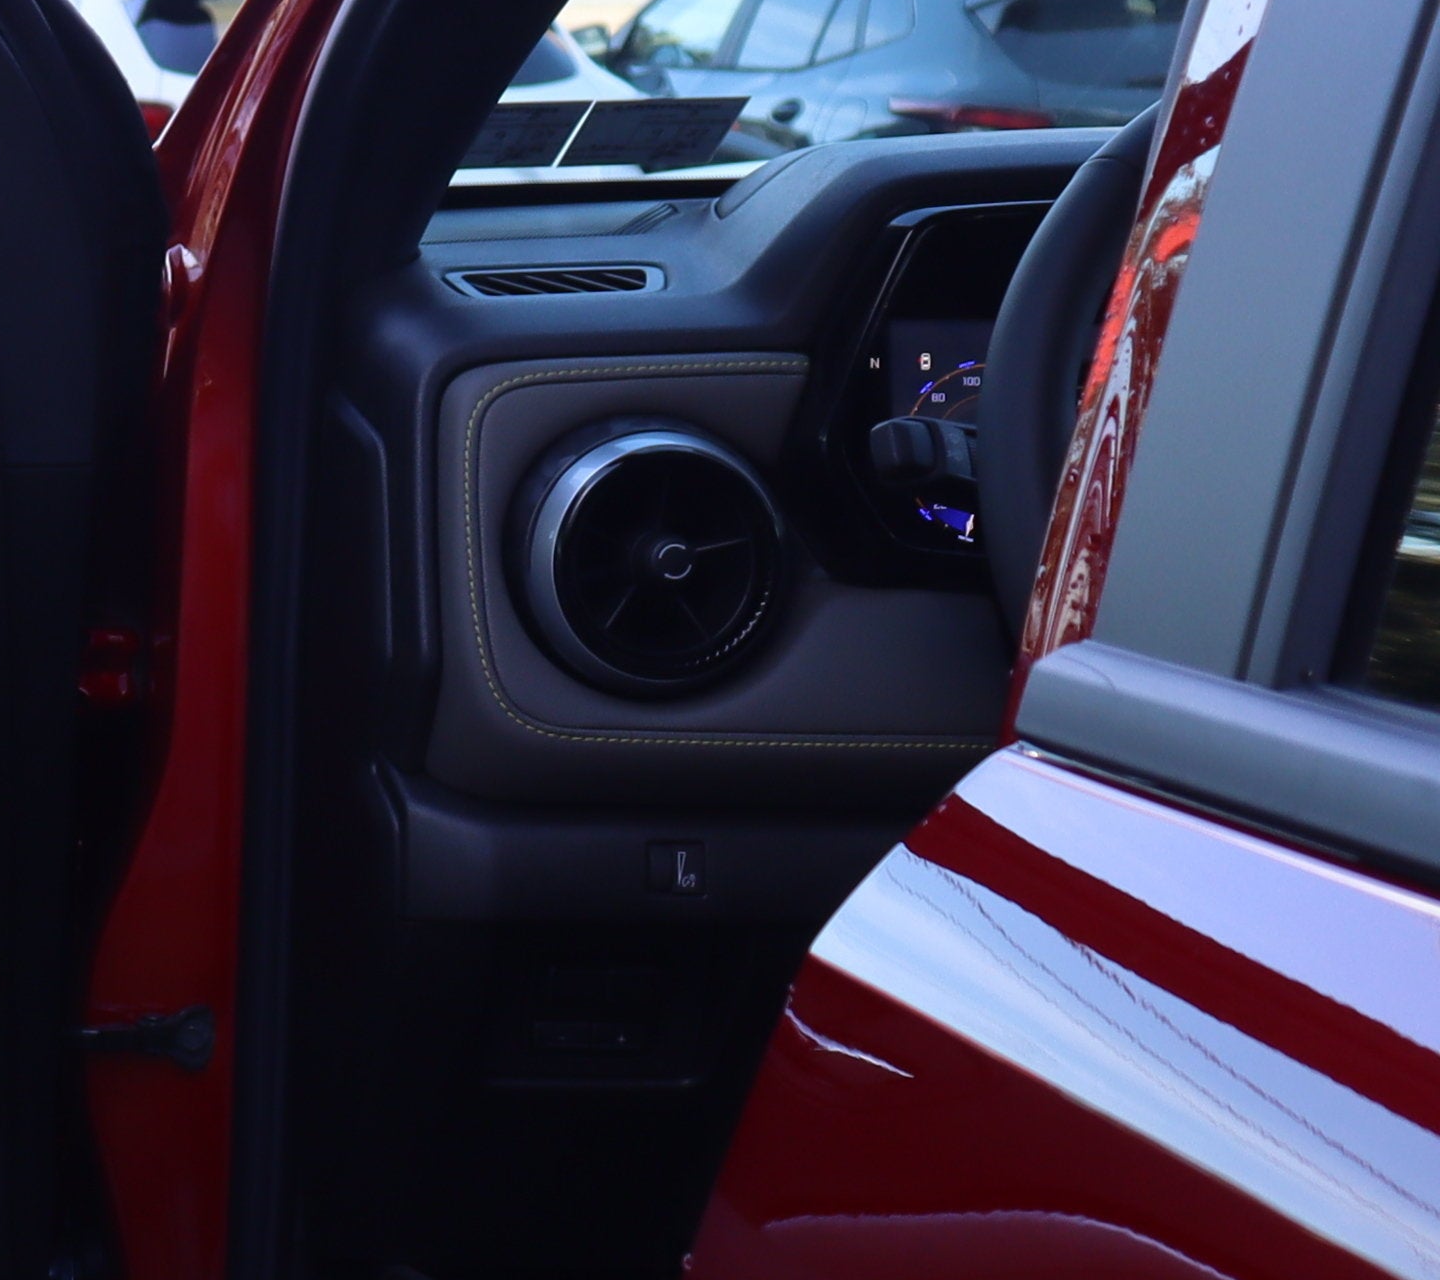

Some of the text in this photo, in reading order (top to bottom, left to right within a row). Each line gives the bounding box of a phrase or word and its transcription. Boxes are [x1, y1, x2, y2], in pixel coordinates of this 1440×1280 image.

[870, 357, 880, 369] N
[962, 376, 981, 386] 100
[931, 392, 946, 403] 80
